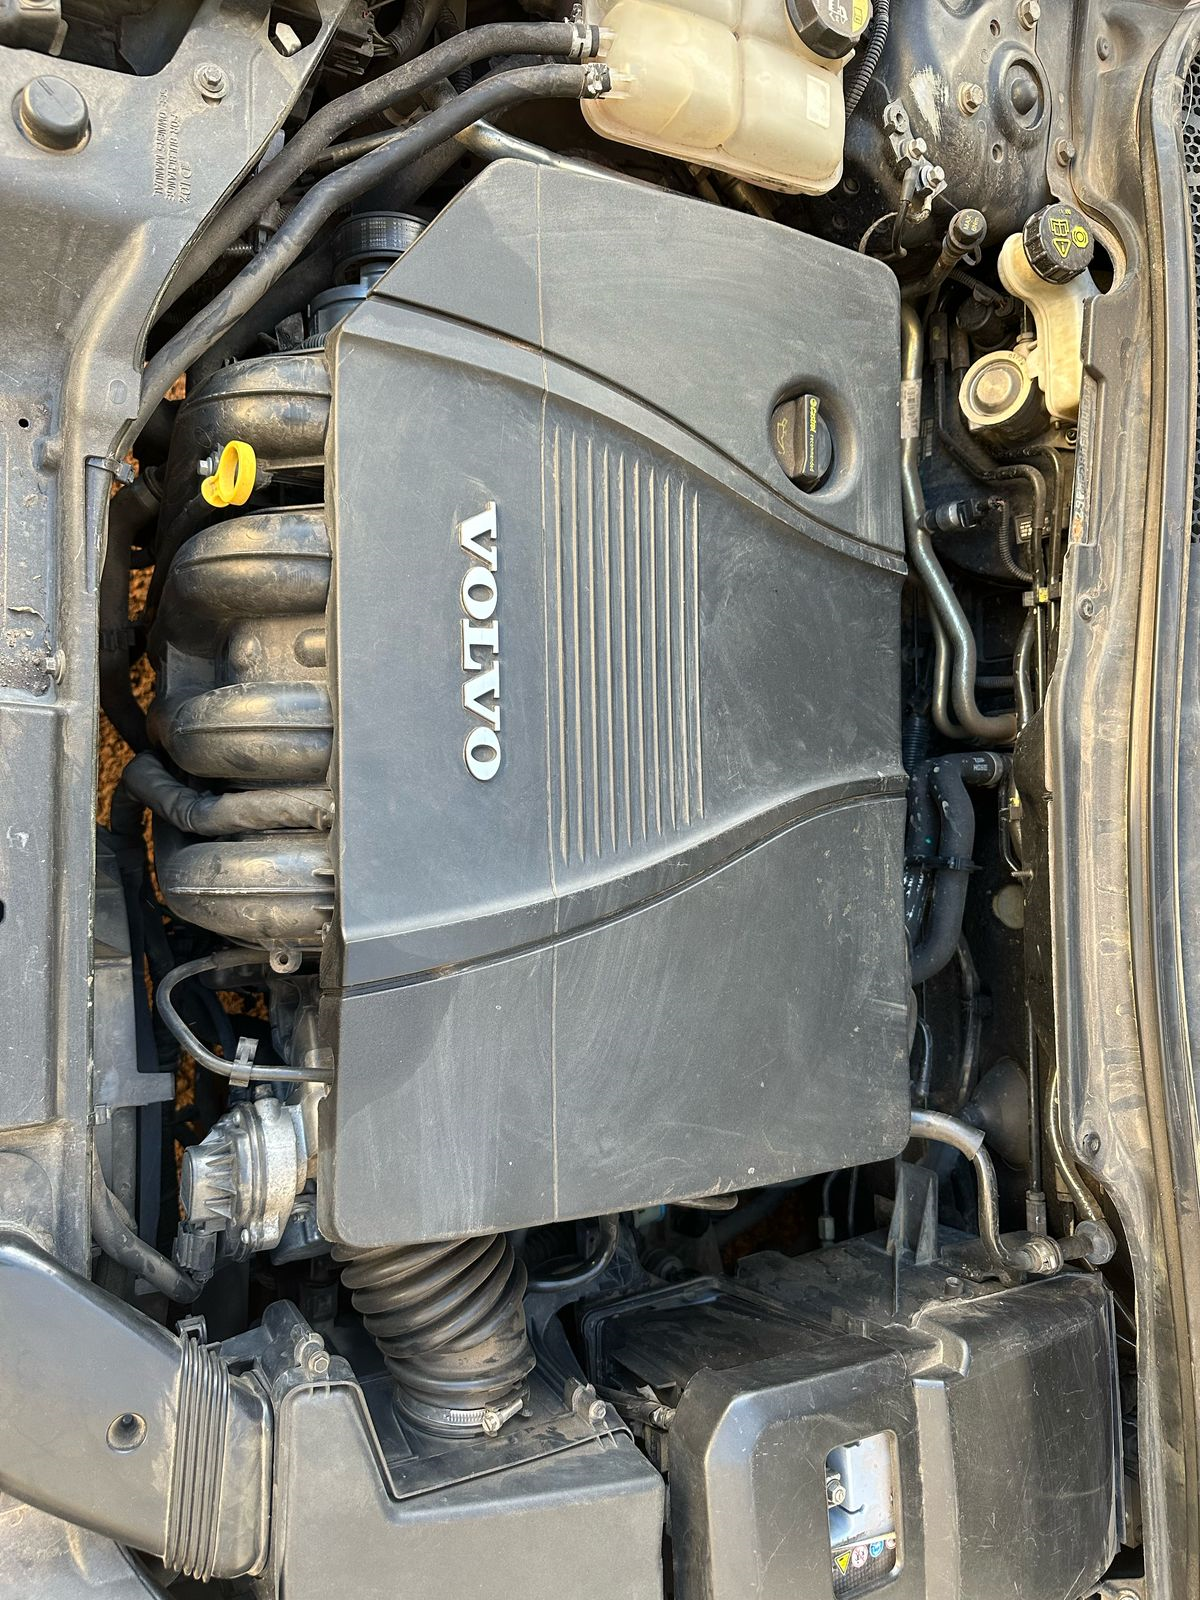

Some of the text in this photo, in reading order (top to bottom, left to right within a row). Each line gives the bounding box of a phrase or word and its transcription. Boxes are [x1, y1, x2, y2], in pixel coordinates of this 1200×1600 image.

[152, 154, 165, 197] MANUAL
[962, 214, 973, 231] MAX
[459, 501, 501, 781] VOLVO
